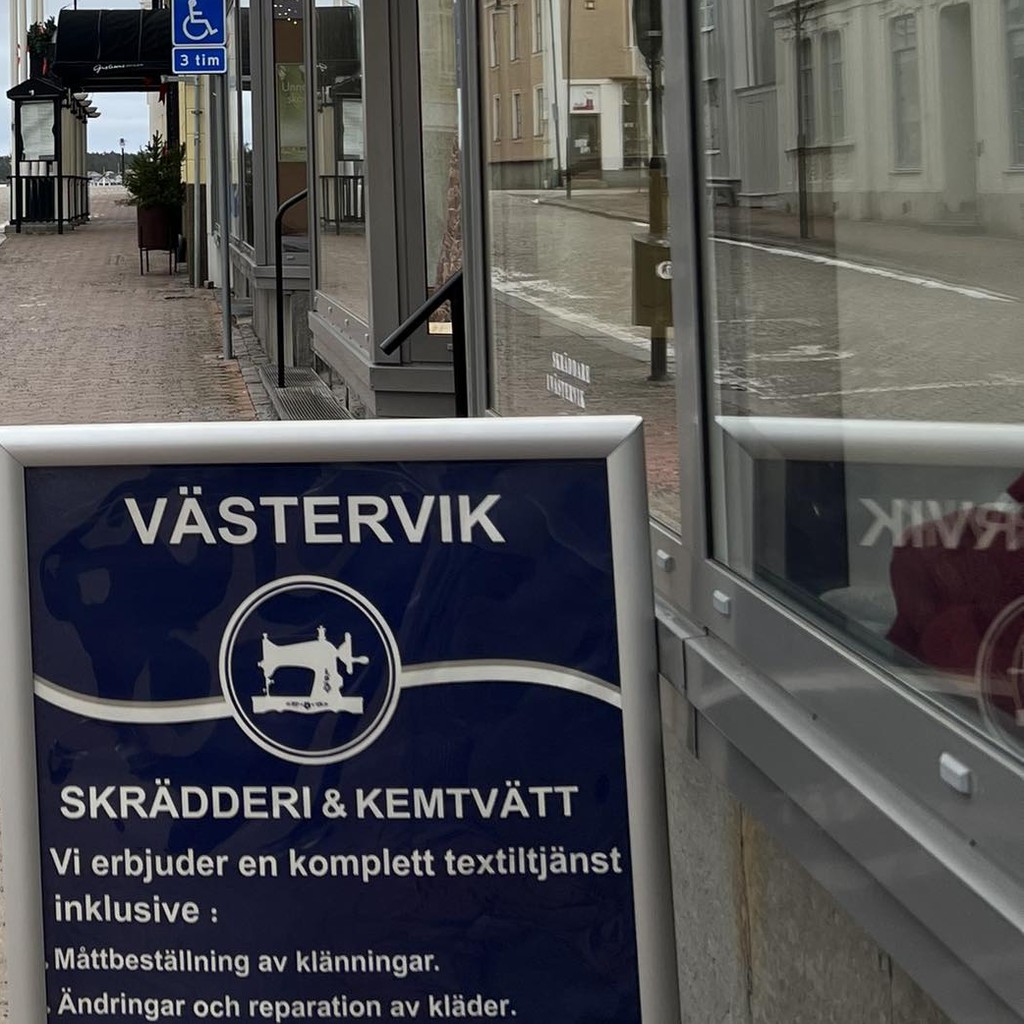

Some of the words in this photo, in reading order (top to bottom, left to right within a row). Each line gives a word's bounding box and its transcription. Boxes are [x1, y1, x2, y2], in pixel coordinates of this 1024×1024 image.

[180, 54, 189, 66] 3
[195, 53, 220, 66] tim
[124, 486, 506, 545] VÄSTERVIK
[60, 778, 312, 819] SKRÄDDERI
[322, 788, 348, 818] &
[356, 780, 579, 819] KEMTVÄTT
[49, 847, 81, 876] Vi
[91, 848, 229, 884] erbjuder
[238, 855, 278, 877] en
[289, 847, 436, 883] komplett
[444, 846, 622, 881] textiltjänst
[55, 893, 200, 924] inklusive
[54, 946, 250, 978] Måttbeställning
[258, 954, 288, 973] av
[296, 949, 440, 978] klänningar.
[57, 987, 186, 1022] Ändringar
[193, 995, 240, 1018] och
[249, 995, 381, 1023] reparation
[390, 1000, 420, 1017] av
[428, 994, 516, 1017] kläder.
